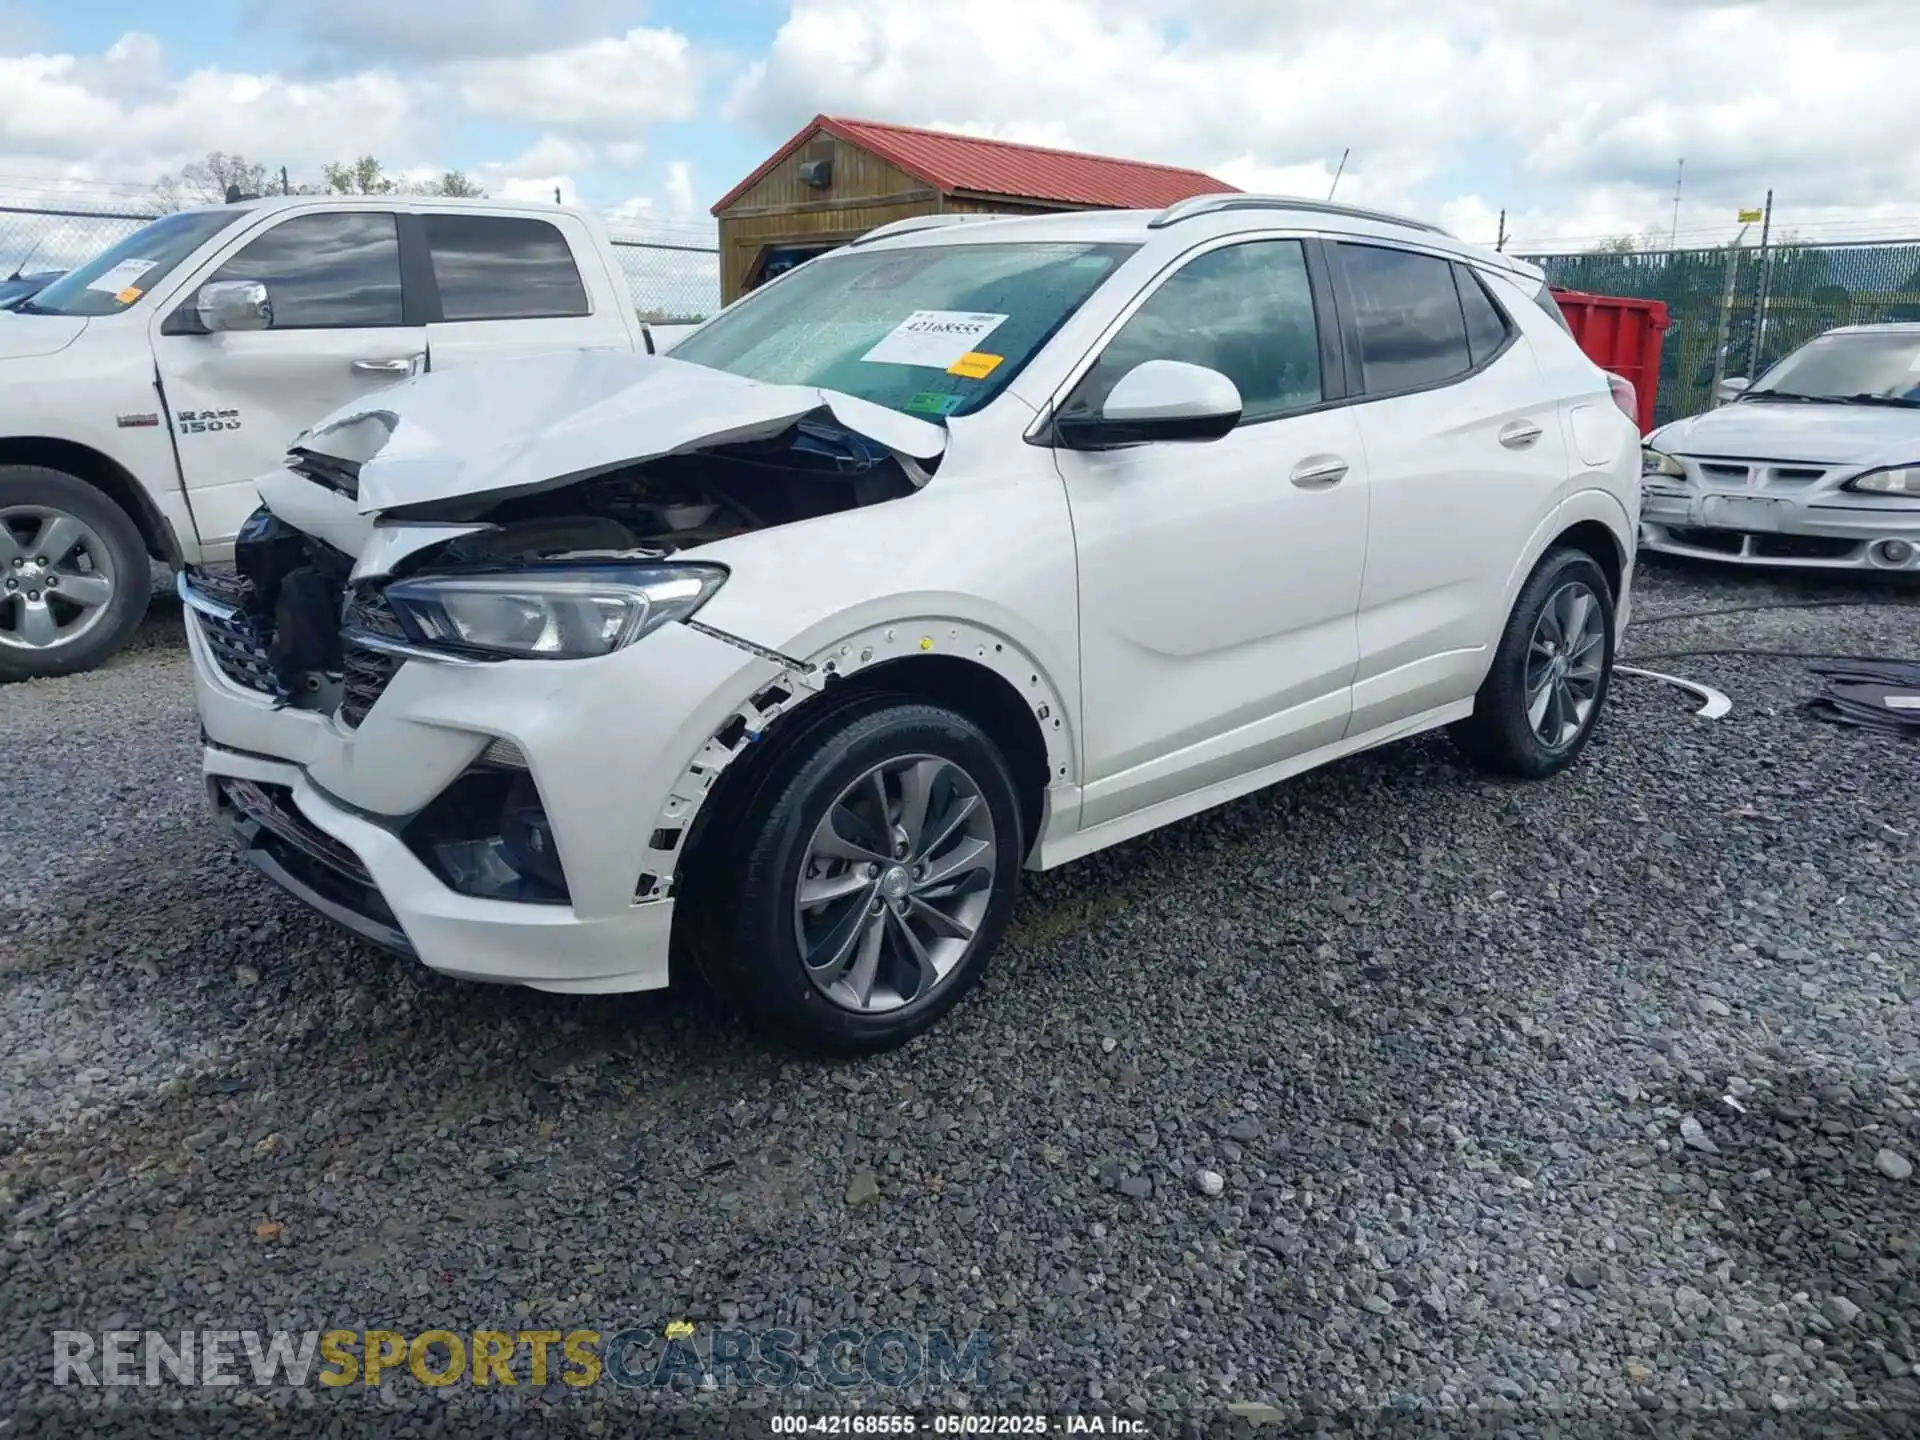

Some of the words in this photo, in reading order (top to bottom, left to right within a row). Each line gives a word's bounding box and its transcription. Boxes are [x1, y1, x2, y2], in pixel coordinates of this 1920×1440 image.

[906, 321, 984, 334] 42168555
[177, 409, 239, 421] RAM
[179, 420, 241, 434] 1500
